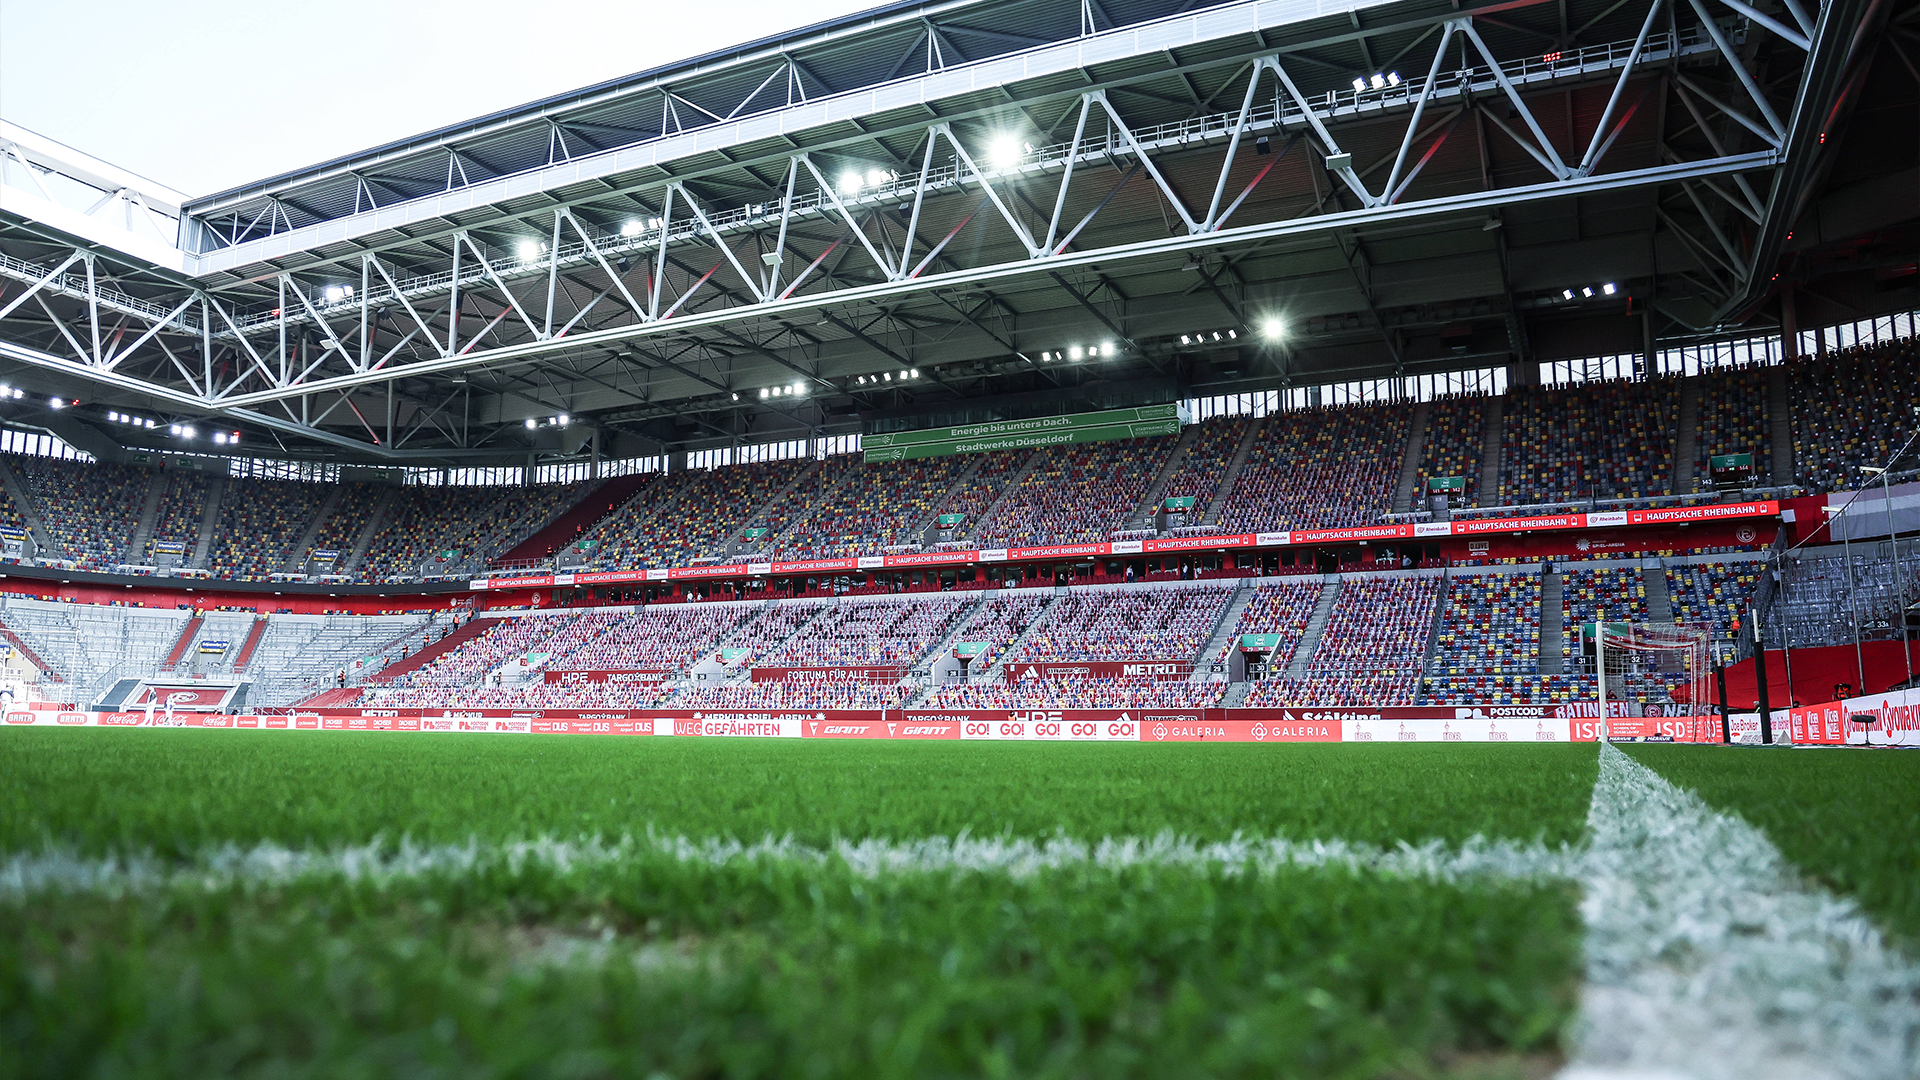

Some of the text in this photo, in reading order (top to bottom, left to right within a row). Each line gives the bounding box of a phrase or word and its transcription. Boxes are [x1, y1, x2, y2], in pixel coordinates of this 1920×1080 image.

[951, 417, 1072, 436] Energie bis unters Dach.
[956, 433, 1073, 452] Stadtwerke Düsseldorf
[1647, 505, 1755, 521] HAUPTSACHE RHEINBAHN
[1469, 518, 1567, 531] HAUPTSACHE RHEINBAHN
[1306, 528, 1396, 540] HAUPTSACHE RHEINBAHN
[1157, 538, 1240, 549] HAUPTSACHE RHEINBAHN
[1021, 546, 1096, 556] HAUPTSACHE RHEINBAHN
[896, 554, 965, 564] HAUPTSACHE RHEINBAHN
[709, 567, 736, 575] RHEINBAHN
[782, 561, 845, 571] HAUPTSACHE RHEINBAHN
[787, 668, 870, 680] FORTUNA FÜR ALLE
[1123, 664, 1177, 675] METRO
[562, 673, 588, 683] HPE
[1302, 711, 1381, 720] Stölting
[1490, 707, 1544, 716] POSTCODE
[8, 714, 33, 722] BRATA
[60, 715, 85, 723] BRATA
[552, 722, 568, 731] DUS
[593, 723, 610, 732] DUS
[635, 723, 652, 732] DUS
[675, 721, 780, 735] WEG GEFÄHRTEN
[824, 726, 870, 734] GIANT
[902, 726, 951, 735] GIANT
[966, 723, 989, 735] GO!
[1000, 723, 1024, 735] GO!
[1035, 723, 1060, 736] GO!
[1071, 723, 1097, 736] GO!
[1108, 723, 1134, 736] GO!
[1172, 727, 1225, 736] GALERIA
[1272, 727, 1329, 736] GALERIA
[1576, 723, 1609, 739] ISD
[1656, 722, 1686, 738] ISD
[1355, 732, 1372, 741] IDR
[1398, 732, 1416, 741] IDR
[1443, 732, 1462, 741] IDR
[1489, 732, 1508, 741] IDR
[1536, 732, 1556, 741] IDR
